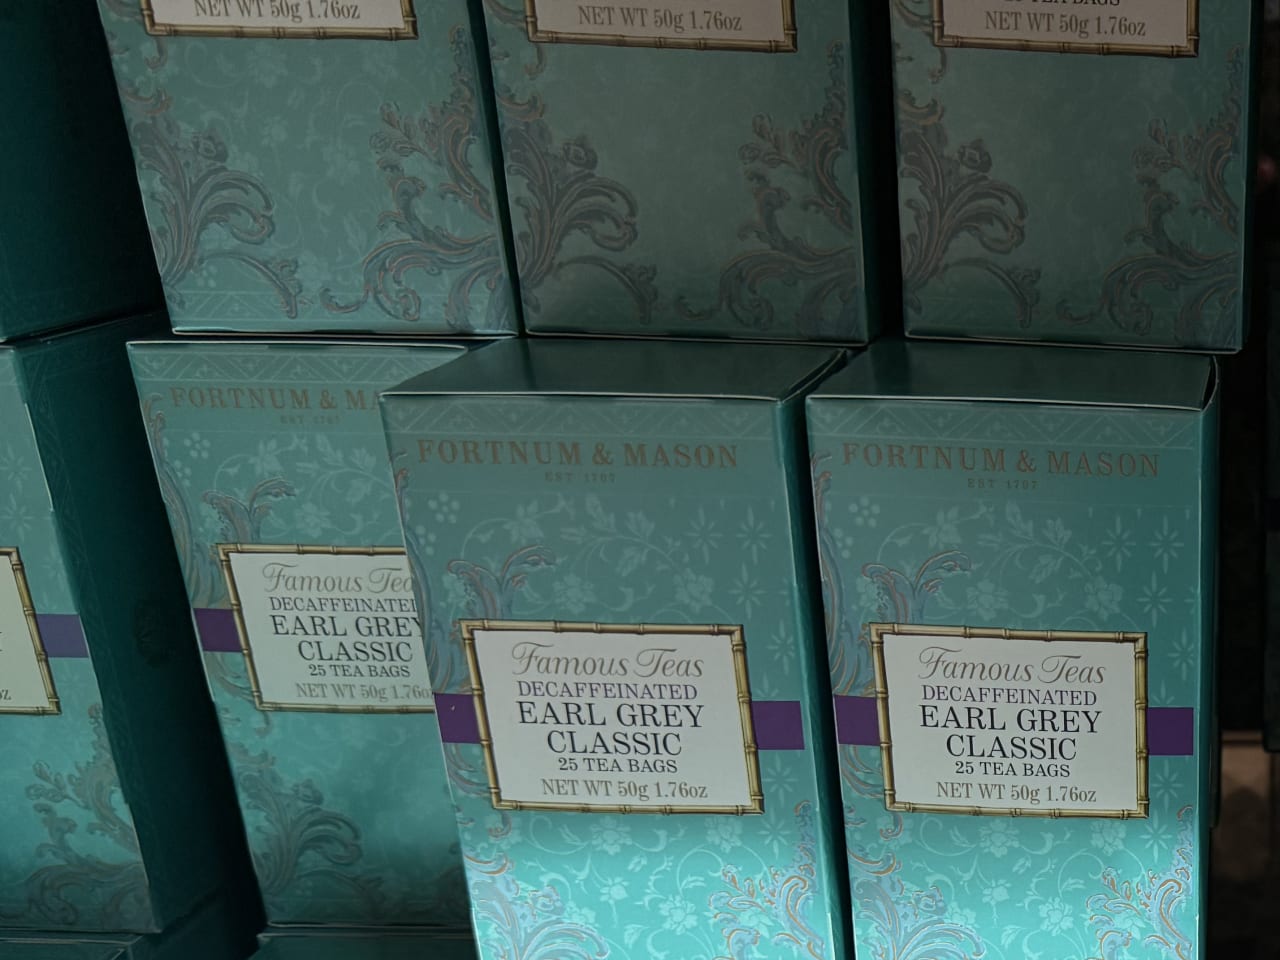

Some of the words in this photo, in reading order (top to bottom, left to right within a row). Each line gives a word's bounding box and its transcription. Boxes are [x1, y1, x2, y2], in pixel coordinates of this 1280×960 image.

[578, 5, 615, 26] NET
[622, 7, 649, 28] WT
[653, 9, 684, 32] 50g
[691, 11, 742, 31] 1.76oz
[170, 387, 310, 411] FORTNUM
[320, 391, 337, 410] &
[842, 443, 1005, 472] FORTNUM
[1016, 450, 1037, 472] &
[1047, 451, 1160, 477] MASON
[270, 614, 348, 637] EARL
[298, 640, 414, 663] CLASSIC
[517, 680, 698, 700] DECAFFEINATED
[922, 685, 1097, 706] DECAFFEINATED
[516, 701, 606, 726] EARL
[616, 703, 704, 728] GREY
[919, 705, 1006, 730] EARL
[1017, 708, 1102, 733] GREY
[547, 730, 682, 756] CLASSIC
[946, 734, 1076, 761] CLASSIC
[558, 757, 578, 771] 25
[583, 758, 624, 772] TEA
[627, 759, 678, 773] BAGS
[955, 761, 974, 775] 25
[979, 762, 1018, 776] TEA
[1022, 763, 1070, 778] BAGS
